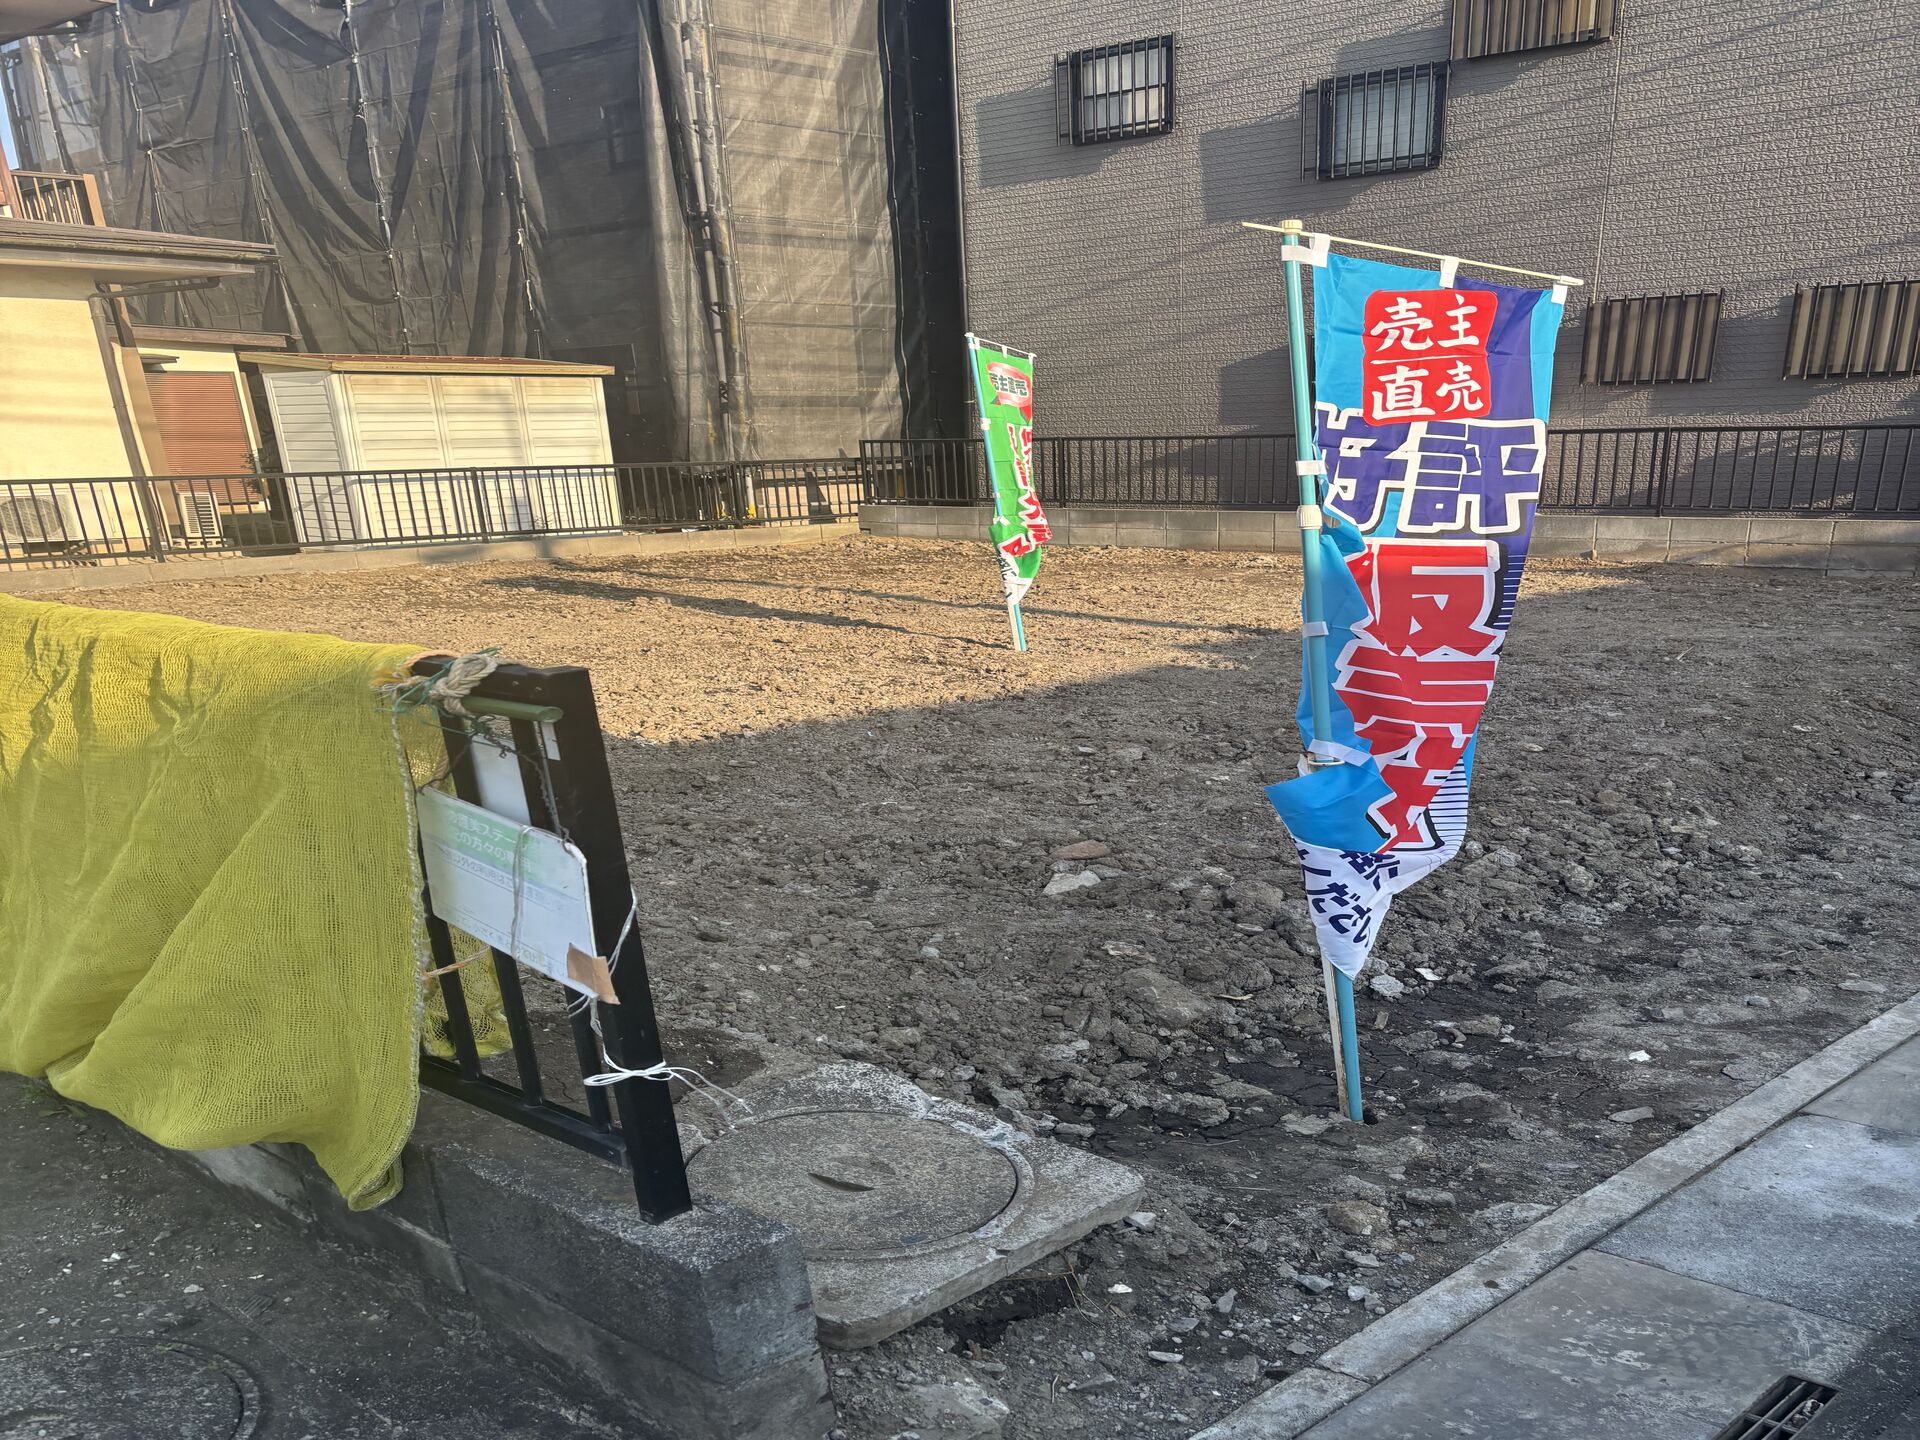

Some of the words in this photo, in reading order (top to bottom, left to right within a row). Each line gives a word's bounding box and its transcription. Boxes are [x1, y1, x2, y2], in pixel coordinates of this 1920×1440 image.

[1370, 293, 1482, 353] 売主
[1371, 360, 1485, 421] 直売
[1315, 403, 1545, 531] 好評
